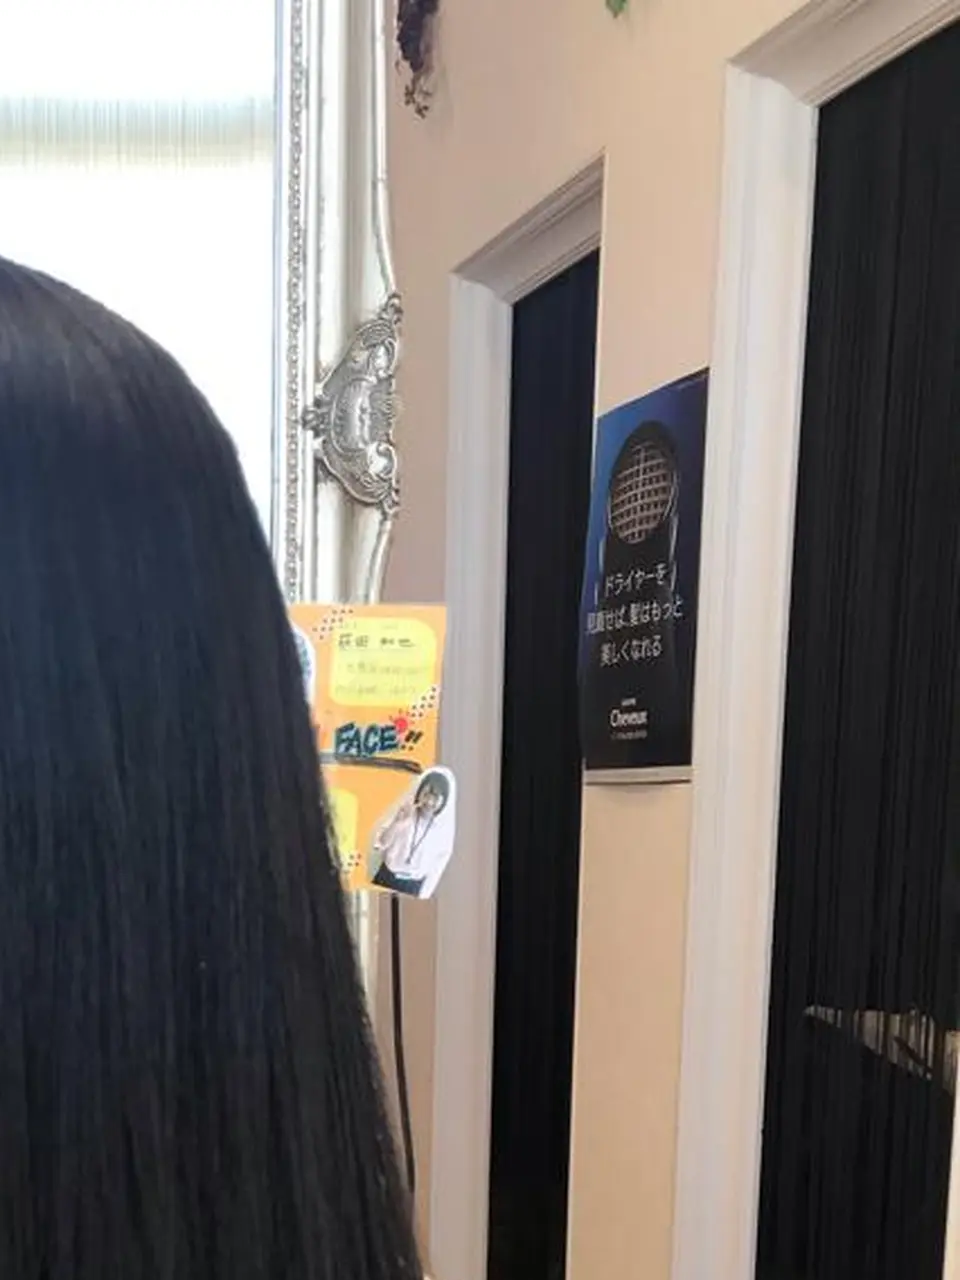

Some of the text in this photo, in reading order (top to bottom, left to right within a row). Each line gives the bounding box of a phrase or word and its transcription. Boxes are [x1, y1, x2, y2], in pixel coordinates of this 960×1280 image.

[604, 563, 667, 598] ドライヤーを
[600, 634, 662, 668] 美しくなれる
